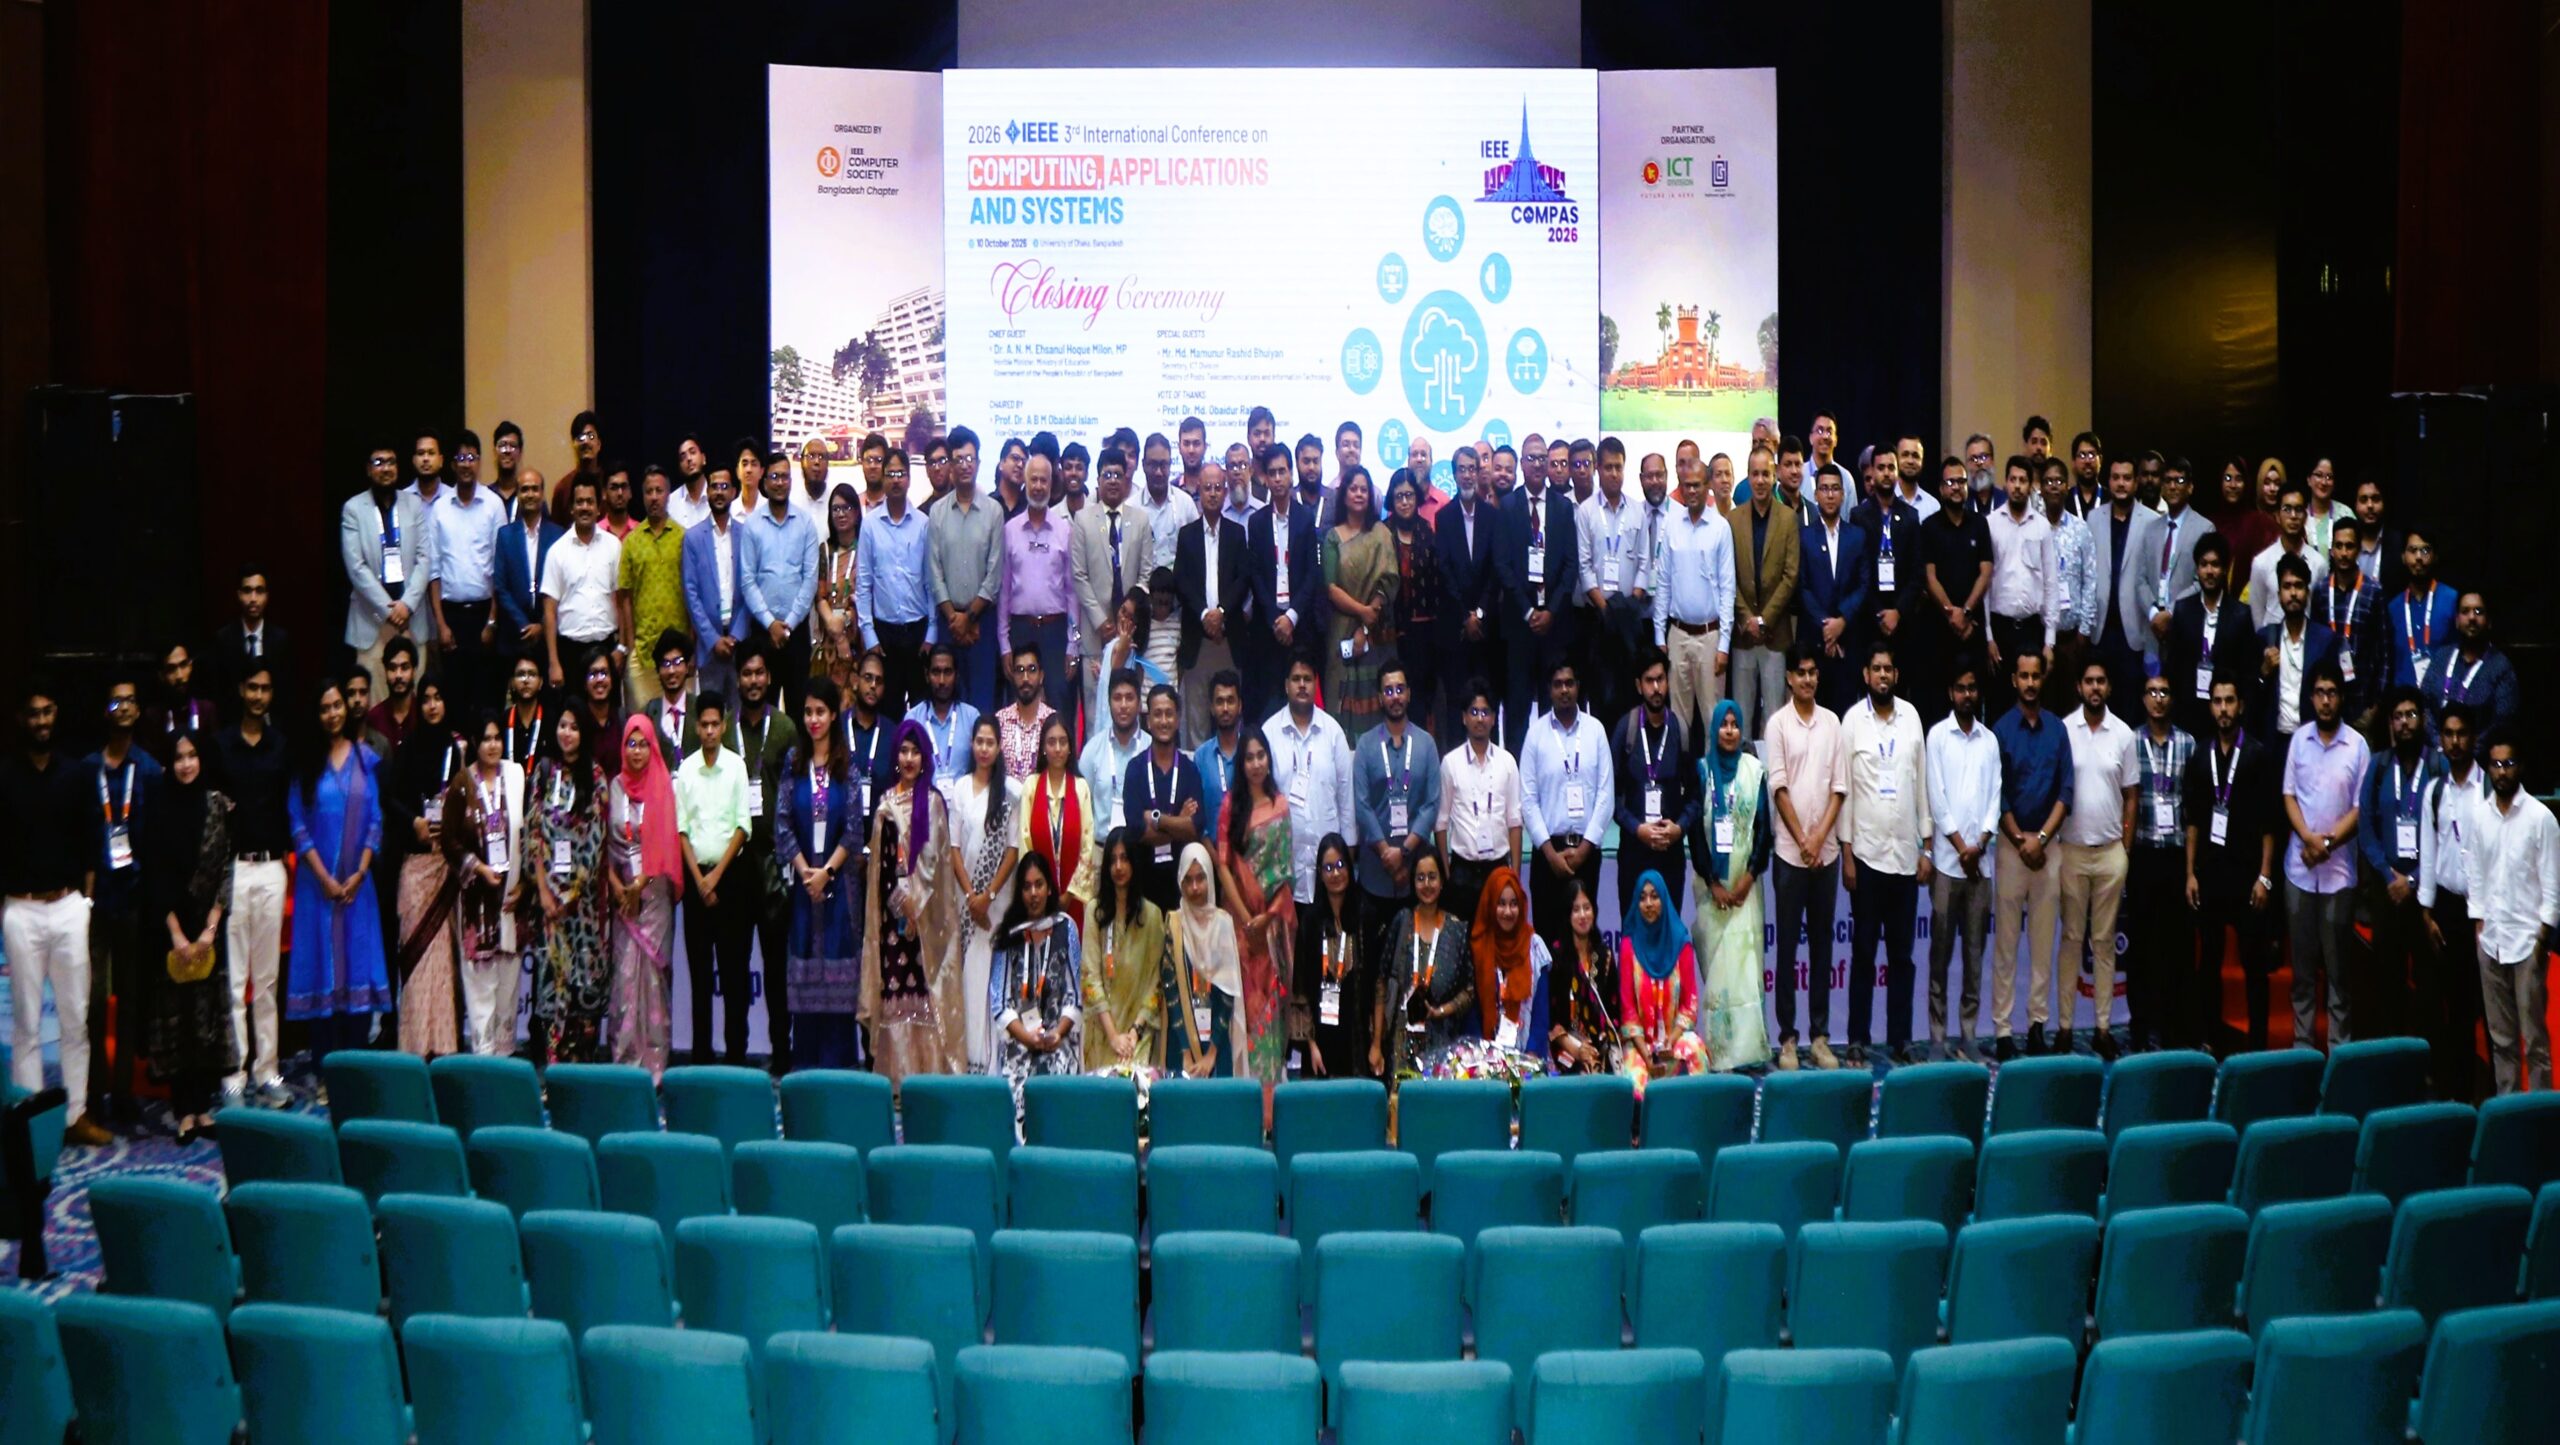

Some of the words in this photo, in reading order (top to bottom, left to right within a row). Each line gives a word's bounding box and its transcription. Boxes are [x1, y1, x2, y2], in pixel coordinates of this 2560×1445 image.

[834, 124, 872, 134] ORGANIZED
[873, 126, 882, 134] BY
[968, 126, 1000, 144] 2026
[1022, 121, 1058, 143] IEEE
[1064, 124, 1080, 143] 3rd
[1083, 125, 1168, 143] International
[1171, 124, 1248, 143] Conference
[1252, 129, 1268, 143] on
[1672, 125, 1704, 134] PARTNER
[1661, 136, 1716, 144] ORGANISATIONS
[1481, 140, 1509, 158] IEEE
[849, 157, 899, 168] COMPUTER
[1667, 157, 1693, 177] ICT
[847, 169, 884, 179] SOCIETY
[969, 156, 1102, 190] COMPUTING,
[1109, 157, 1269, 186] APPLICATIONS
[818, 185, 865, 197] Bangladesh
[867, 186, 899, 197] Chapter
[970, 197, 1017, 224] AND
[1021, 196, 1124, 224] SYSTEMS
[1511, 206, 1579, 224] COMPAS
[1548, 227, 1578, 243] 2026
[976, 238, 984, 248] 10
[985, 238, 1009, 248] October
[990, 259, 1109, 331] Closing
[1117, 273, 1225, 323] Ceremony
[989, 329, 1005, 338] CHIEF
[1007, 329, 1026, 338] GUEST
[1157, 329, 1180, 338] SPECIAL
[1183, 329, 1205, 338] GUESTS
[1035, 344, 1065, 354] Ehsanul
[1067, 344, 1090, 357] Hoque
[1116, 344, 1127, 354] MP
[1190, 347, 1224, 358] Mamunur
[1227, 347, 1251, 358] Rashid
[1253, 347, 1284, 360] Bhuiyan
[1157, 390, 1172, 399] VOTE
[1173, 390, 1181, 399] OF
[1183, 390, 1206, 399] THANKS
[1016, 400, 1023, 409] BY
[1182, 405, 1192, 415] Dr.
[1209, 405, 1238, 415] Obaidur
[1026, 414, 1032, 424] A
[1034, 414, 1039, 424] B
[1041, 414, 1047, 424] M
[1049, 414, 1076, 424] Obaidul
[1078, 414, 1099, 424] Islam
